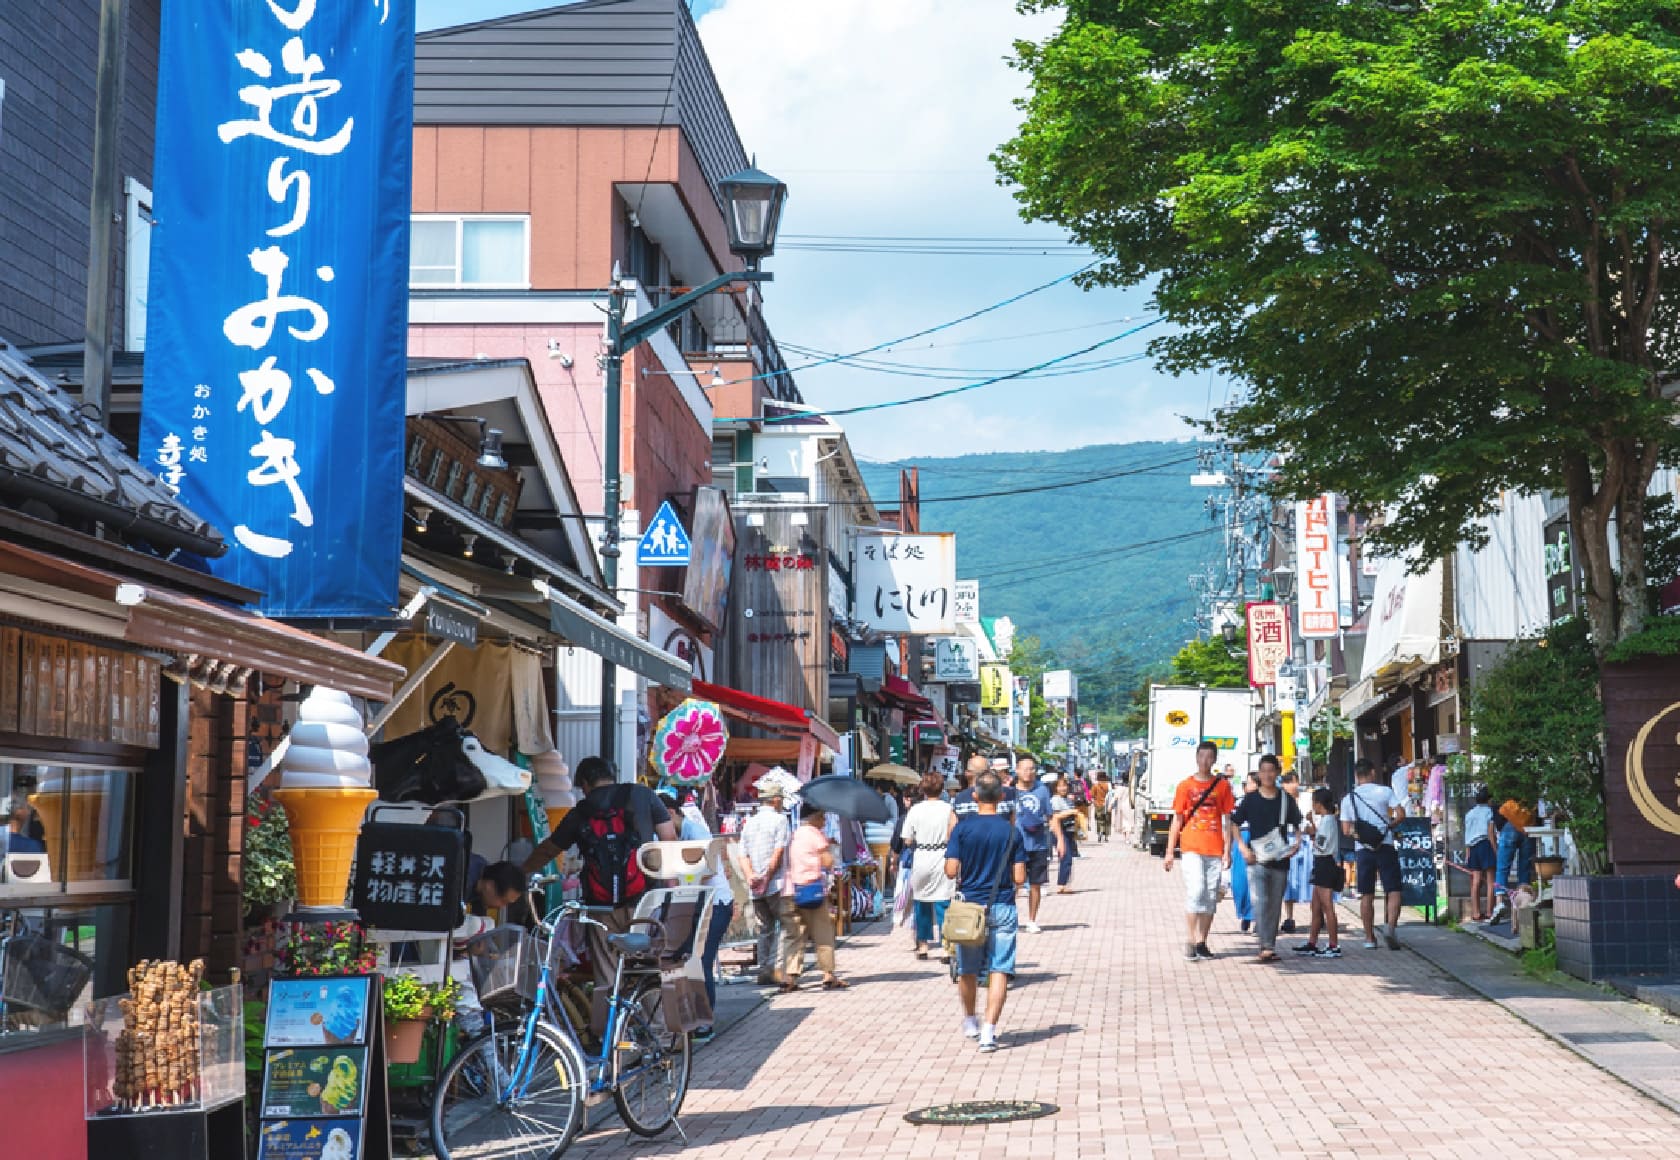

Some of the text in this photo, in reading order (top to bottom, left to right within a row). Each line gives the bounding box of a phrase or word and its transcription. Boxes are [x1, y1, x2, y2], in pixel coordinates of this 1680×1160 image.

[189, 383, 211, 463] おかき処
[864, 543, 925, 560] そば処
[874, 584, 947, 620] にし川
[1255, 621, 1282, 643] 酒
[370, 851, 446, 879] 軽井沢
[367, 878, 445, 906] 物産館
